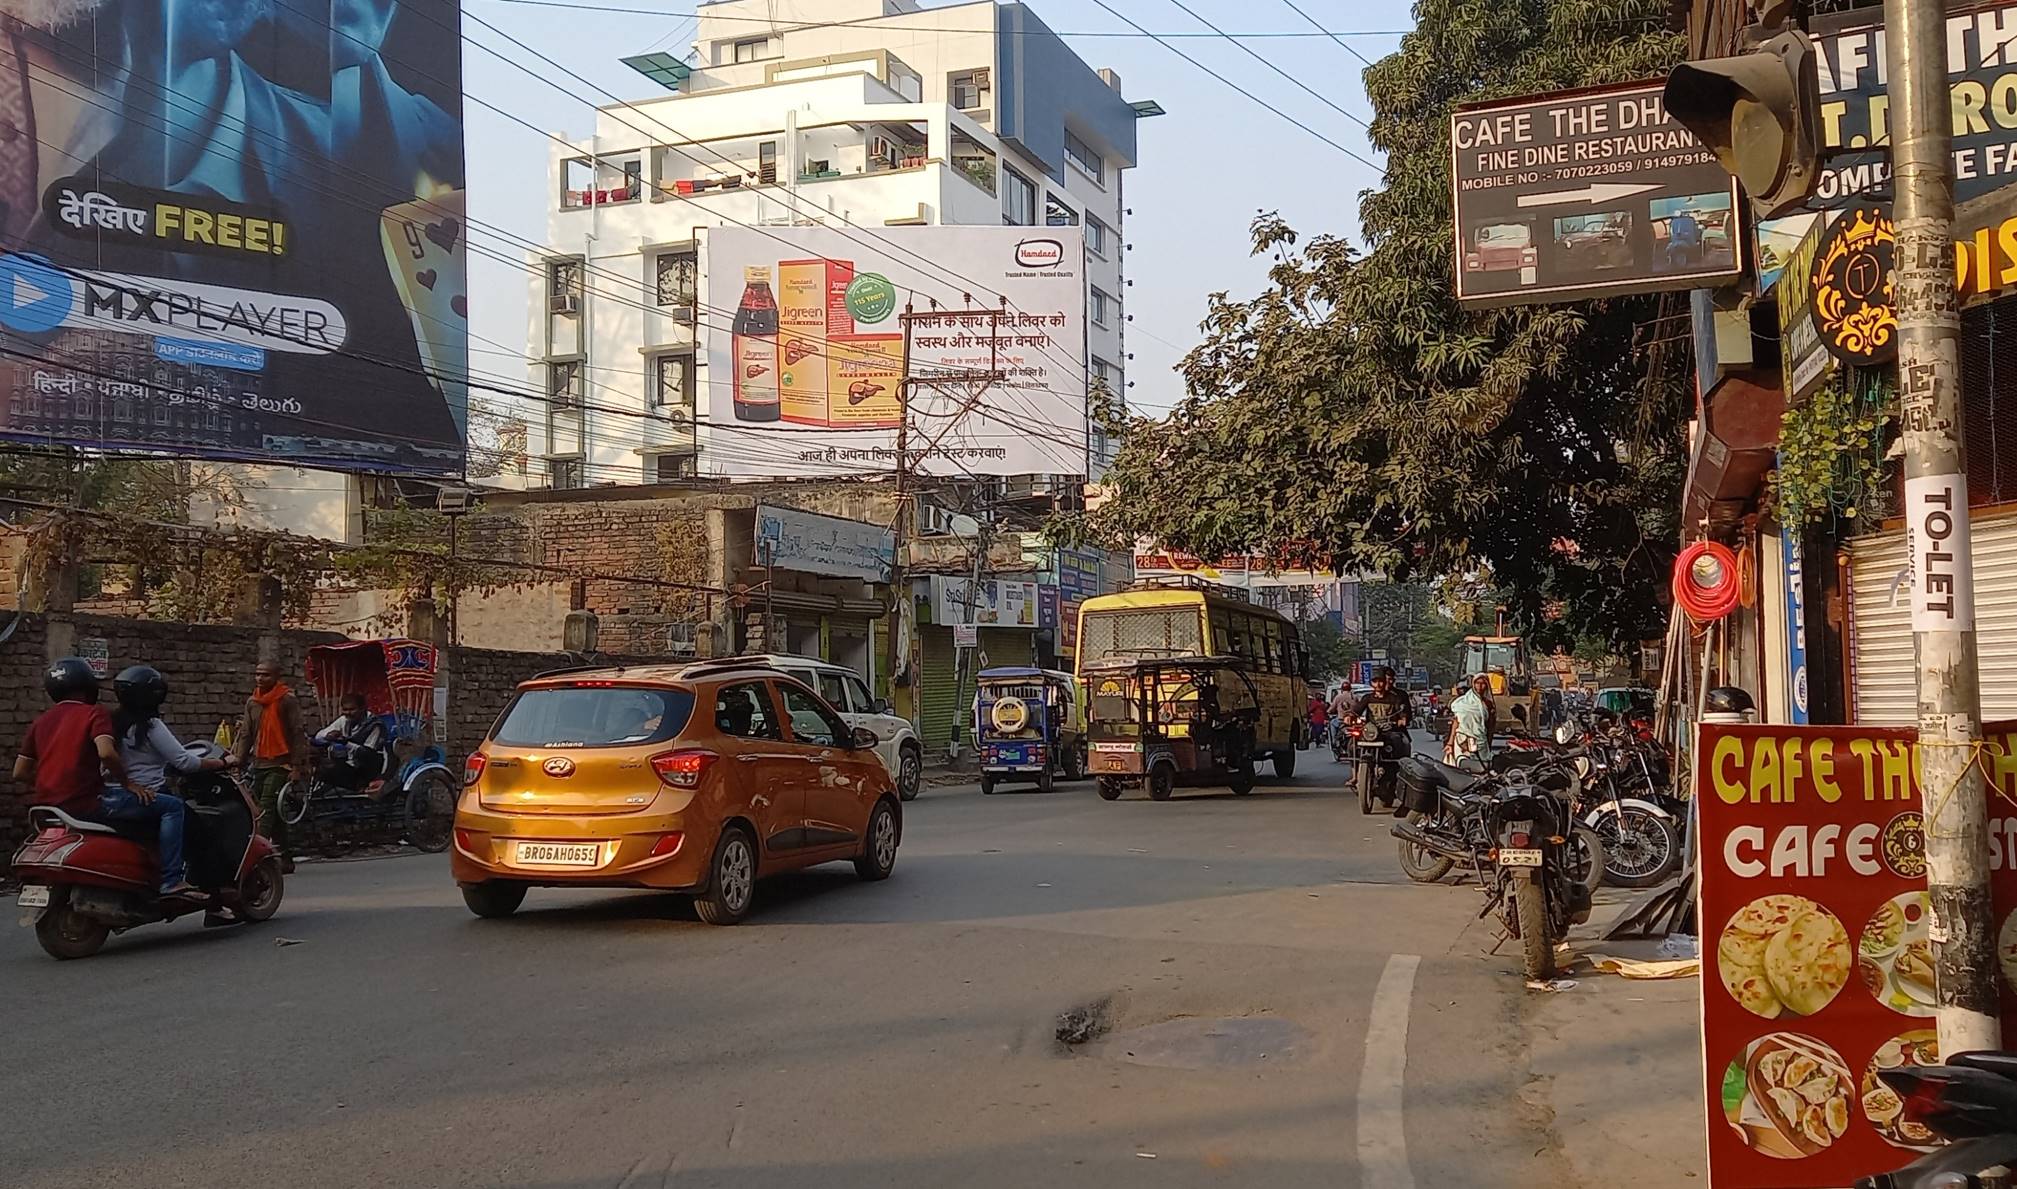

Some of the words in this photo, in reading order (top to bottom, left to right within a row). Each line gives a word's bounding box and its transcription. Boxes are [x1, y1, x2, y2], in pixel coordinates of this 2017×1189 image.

[1455, 113, 1533, 150] CAFE
[1549, 104, 1608, 138] THE
[1477, 149, 1519, 172] FINE
[1524, 143, 1569, 167] DINE
[1574, 129, 1702, 161] RESTAURAN
[1462, 174, 1515, 190] MOBILE
[1518, 171, 1538, 184] NO
[1555, 160, 1633, 180] 7070223059
[58, 189, 147, 234] देखिए
[155, 204, 285, 256] FREE!
[781, 307, 823, 321] Jigreen
[915, 335, 947, 349] स्वस्थ
[949, 331, 972, 348] और
[33, 371, 77, 393] हिन्दी
[799, 450, 822, 462] आज
[825, 447, 836, 461] ही
[838, 449, 868, 461] अपना
[1908, 527, 1916, 588] SERVICE
[1925, 487, 1954, 619] TO-LET
[1711, 736, 1842, 804] CAFE
[1724, 823, 1881, 878] CAFE
